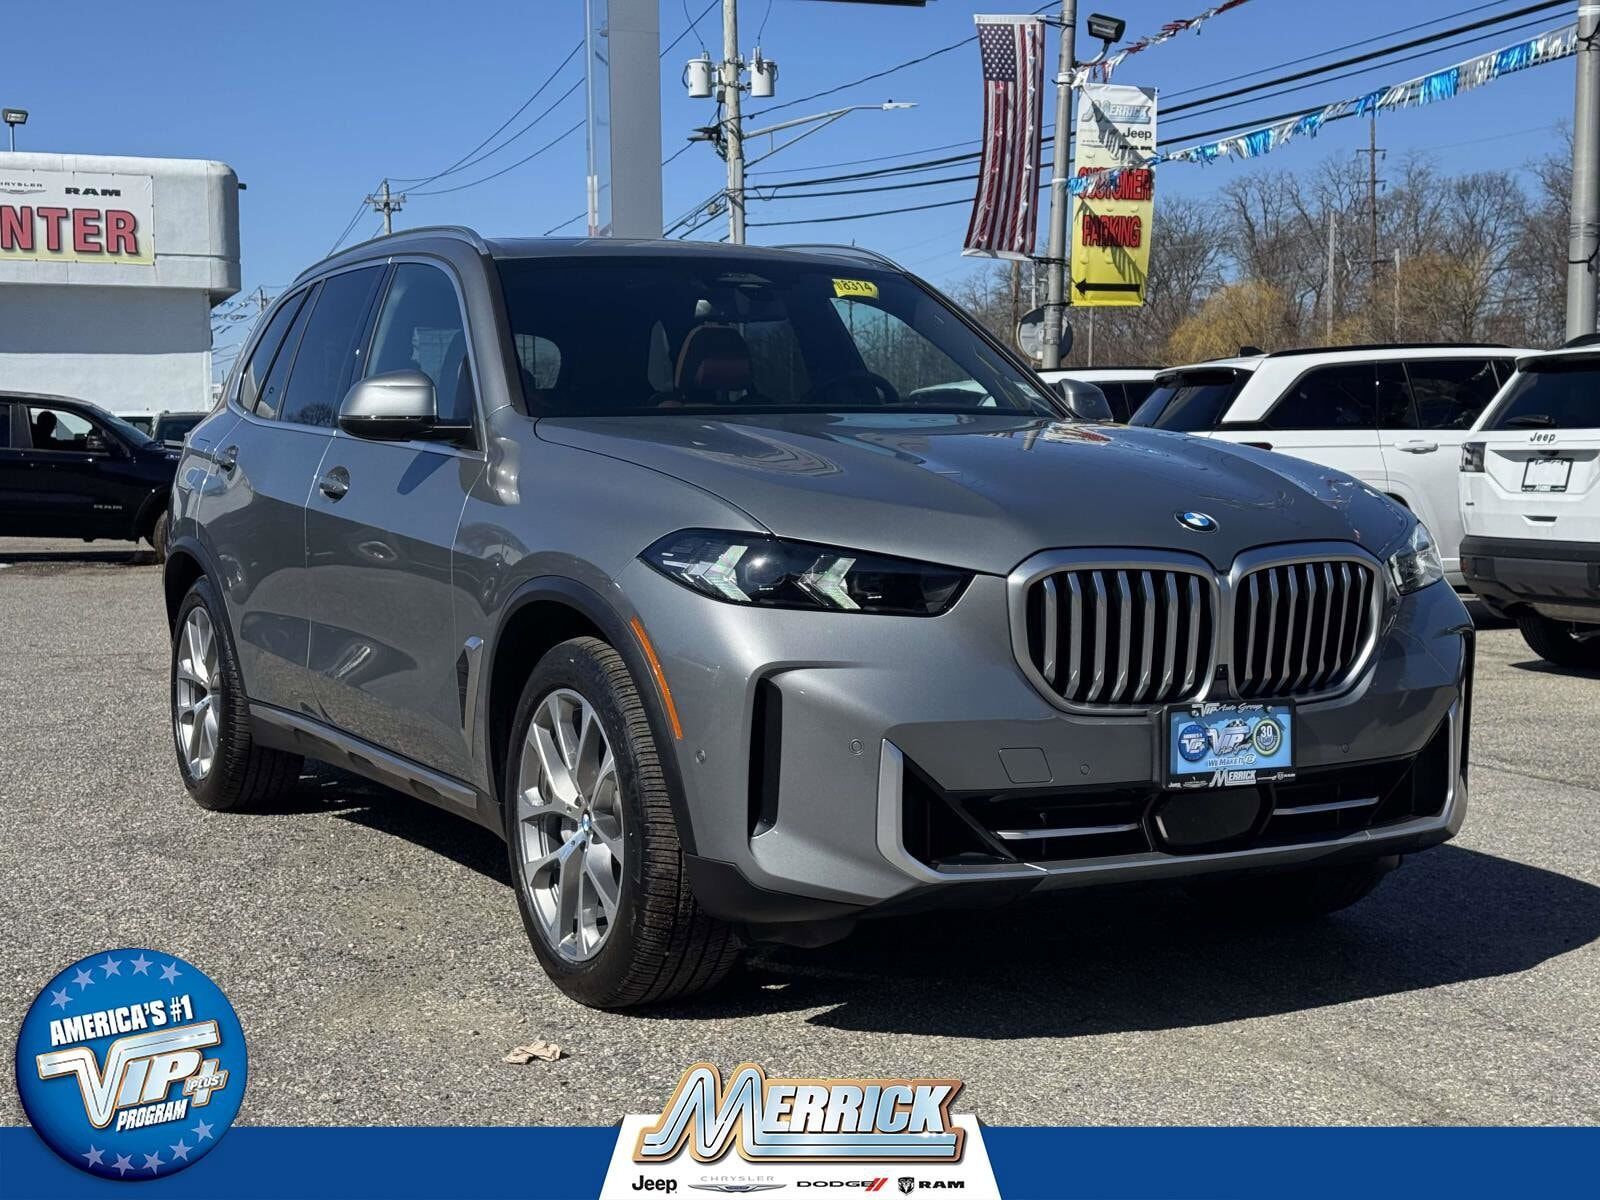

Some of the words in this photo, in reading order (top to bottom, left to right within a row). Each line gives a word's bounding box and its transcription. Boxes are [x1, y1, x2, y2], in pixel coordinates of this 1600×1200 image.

[1081, 99, 1151, 124] MERRICK
[1123, 128, 1152, 141] Jeep
[65, 187, 121, 197] RAM
[0, 205, 138, 255] NTER
[1082, 214, 1141, 248] PARKING
[1530, 432, 1556, 443] Jeep
[1218, 703, 1236, 712] Auto
[1238, 702, 1263, 713] Group
[1261, 725, 1273, 738] 30
[1207, 726, 1251, 755] VIP
[1208, 768, 1257, 787] MERRICK
